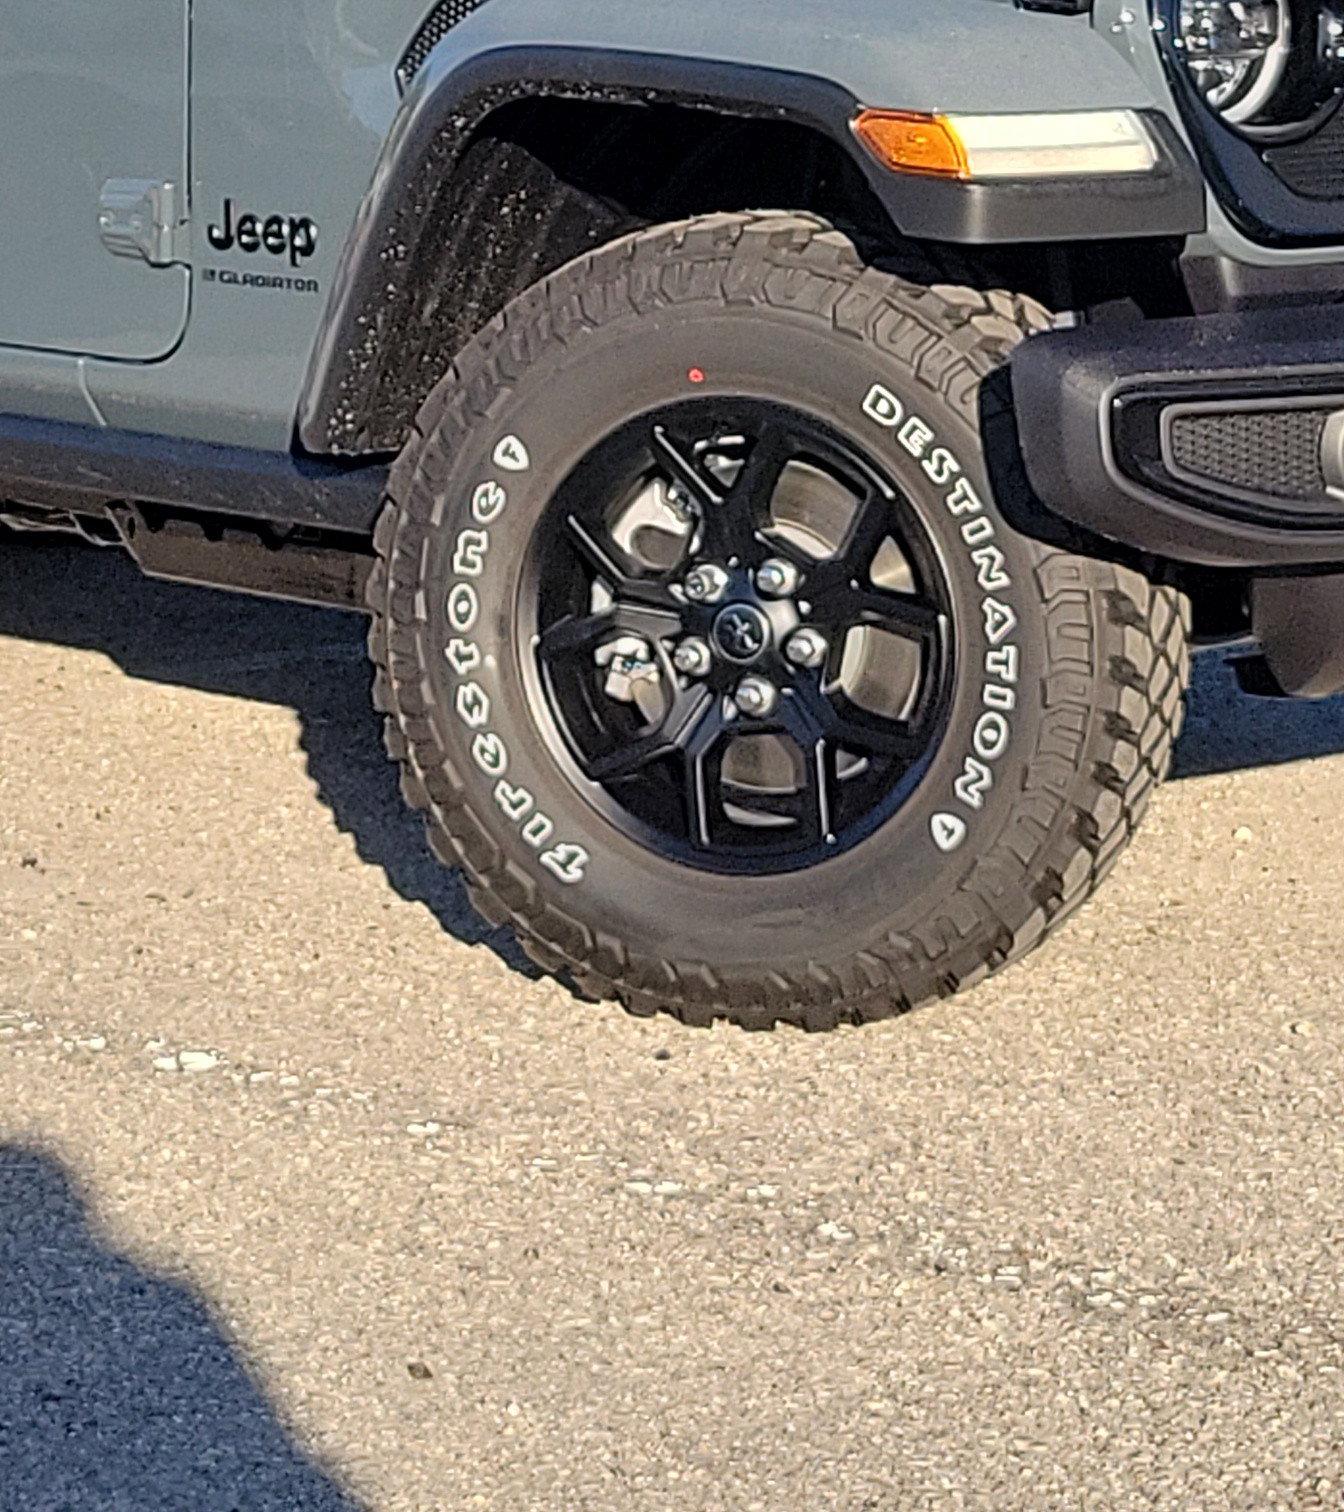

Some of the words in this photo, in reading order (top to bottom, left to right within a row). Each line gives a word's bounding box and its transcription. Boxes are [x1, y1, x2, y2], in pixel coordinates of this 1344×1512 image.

[207, 197, 317, 268] Jeep
[218, 269, 319, 293] GLADIATOR
[862, 383, 1019, 810] DESTINATION
